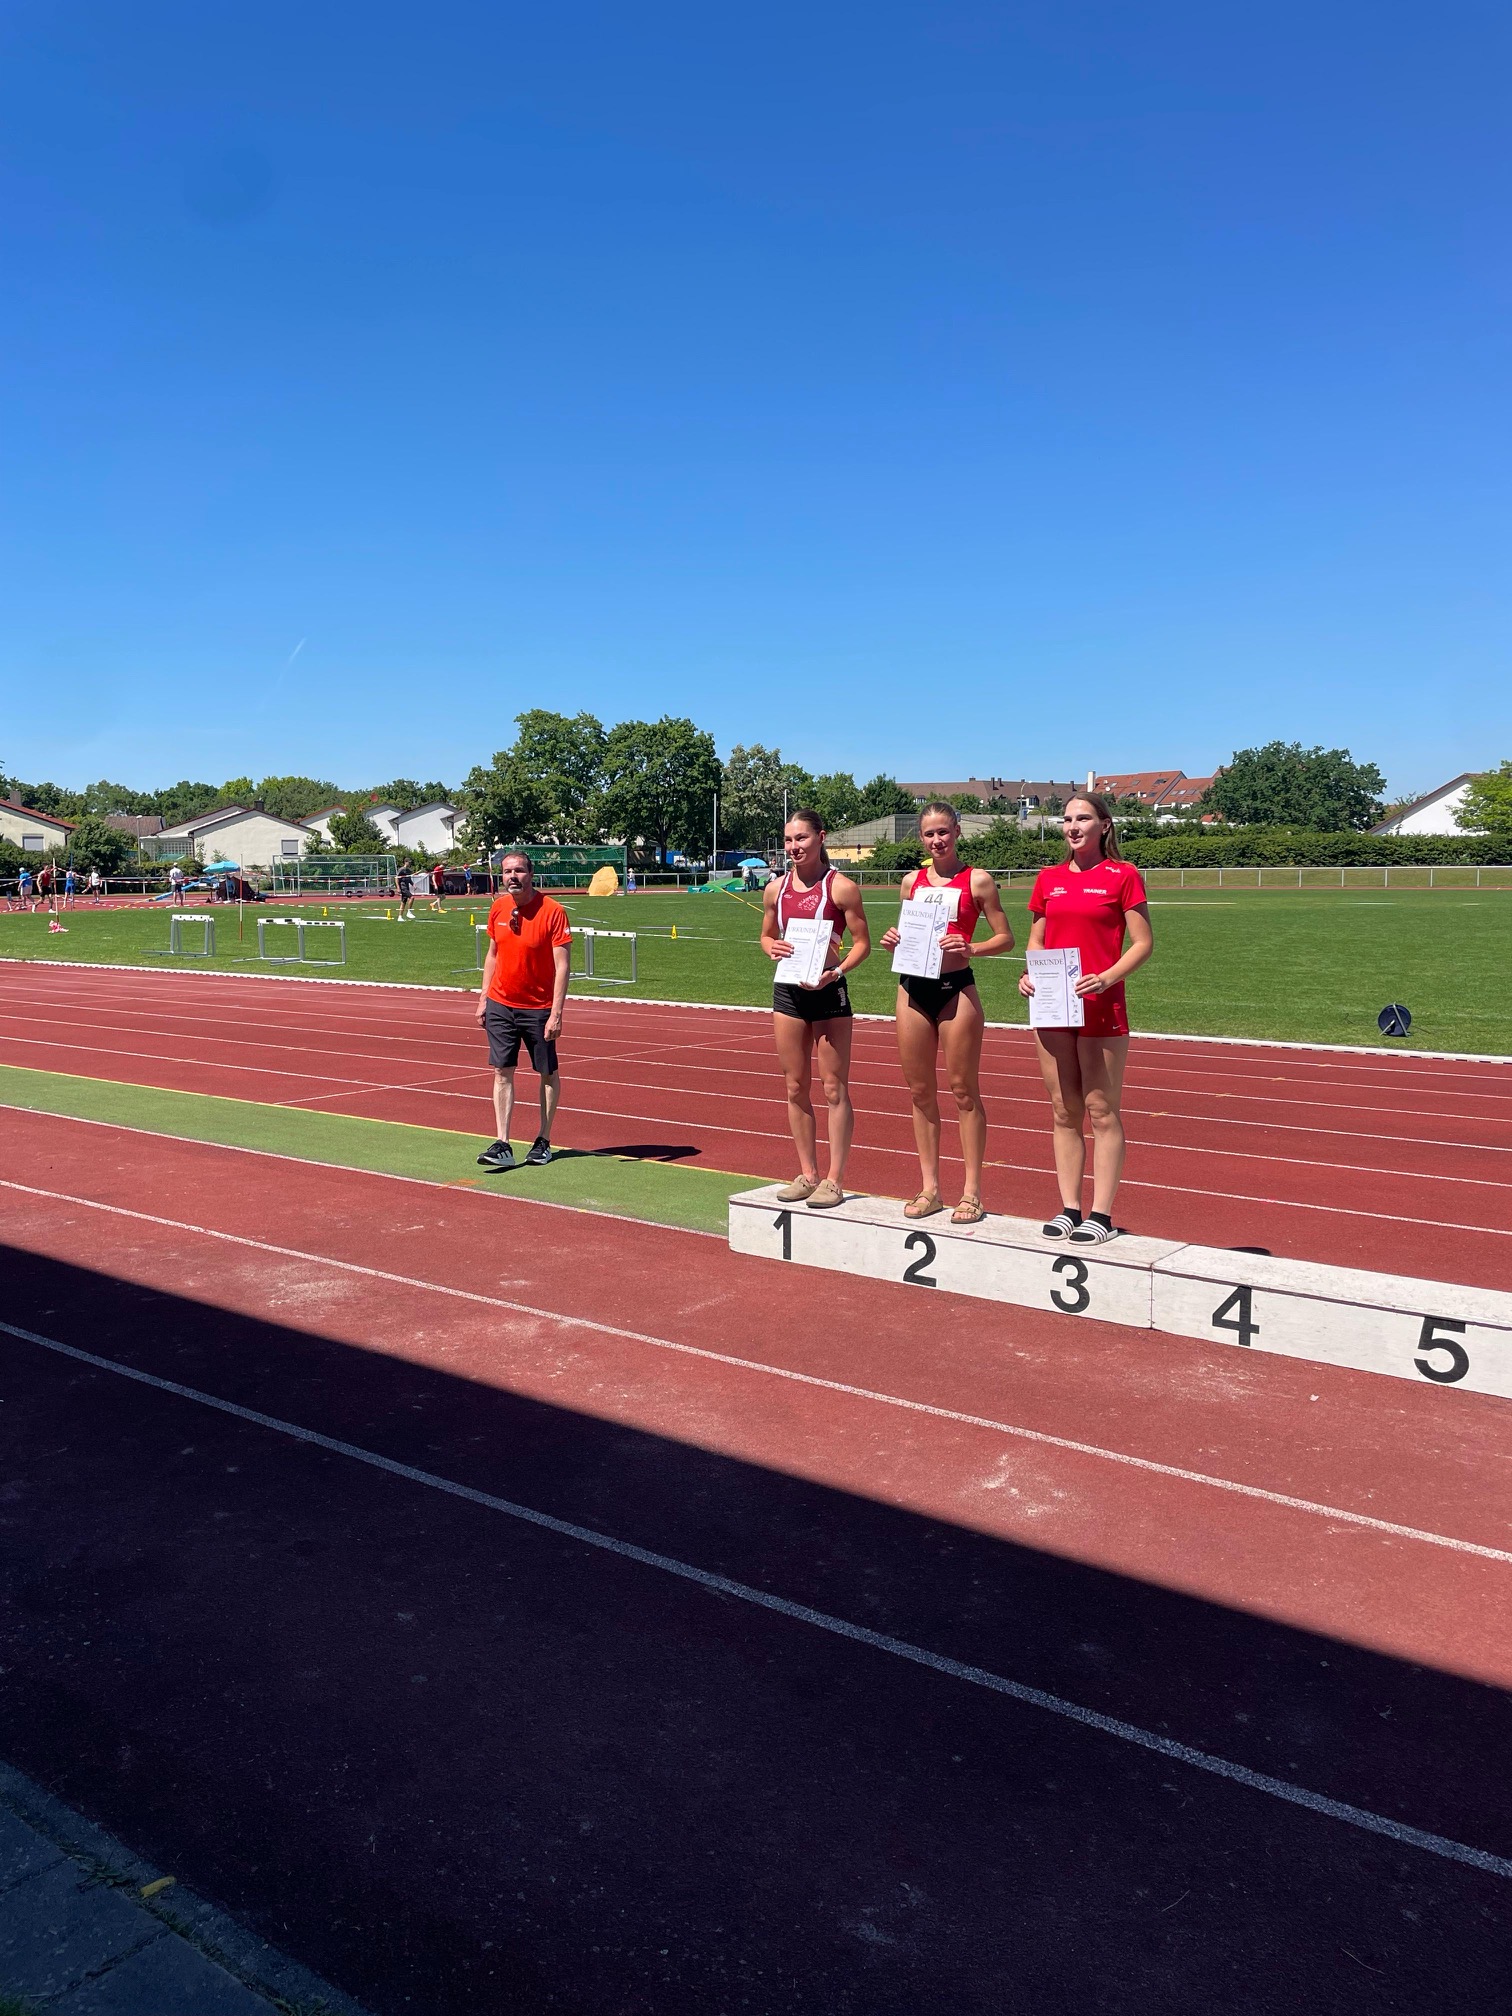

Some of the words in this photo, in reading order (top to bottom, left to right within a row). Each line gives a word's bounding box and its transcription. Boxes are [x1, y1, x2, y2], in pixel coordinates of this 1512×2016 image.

[903, 909, 933, 919] URKUNDE
[924, 893, 943, 905] 44
[773, 1211, 791, 1260] 1
[903, 1231, 937, 1287] 2
[1050, 1255, 1090, 1313] 3
[1212, 1285, 1260, 1347] 4
[1414, 1316, 1469, 1383] 5
